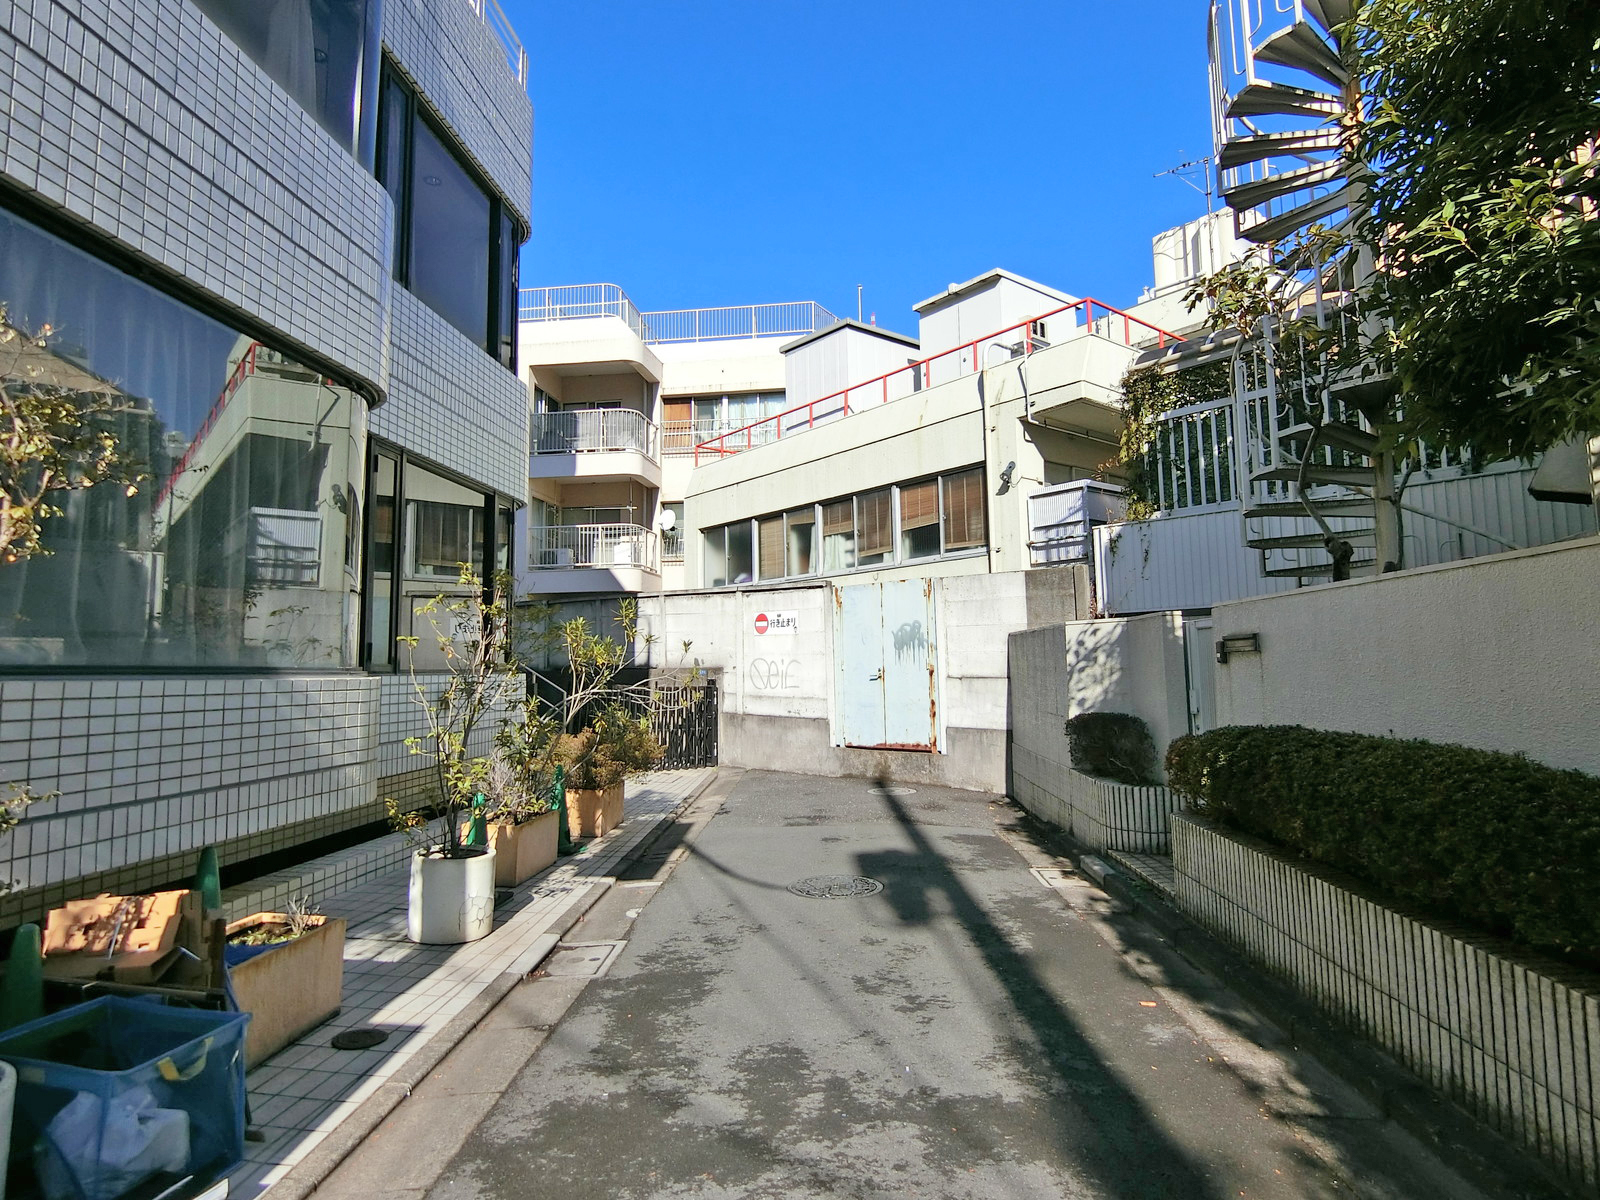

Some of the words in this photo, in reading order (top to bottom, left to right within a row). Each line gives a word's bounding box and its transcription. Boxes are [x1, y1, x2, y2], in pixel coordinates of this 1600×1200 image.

[770, 617, 796, 628] 行き止まり
